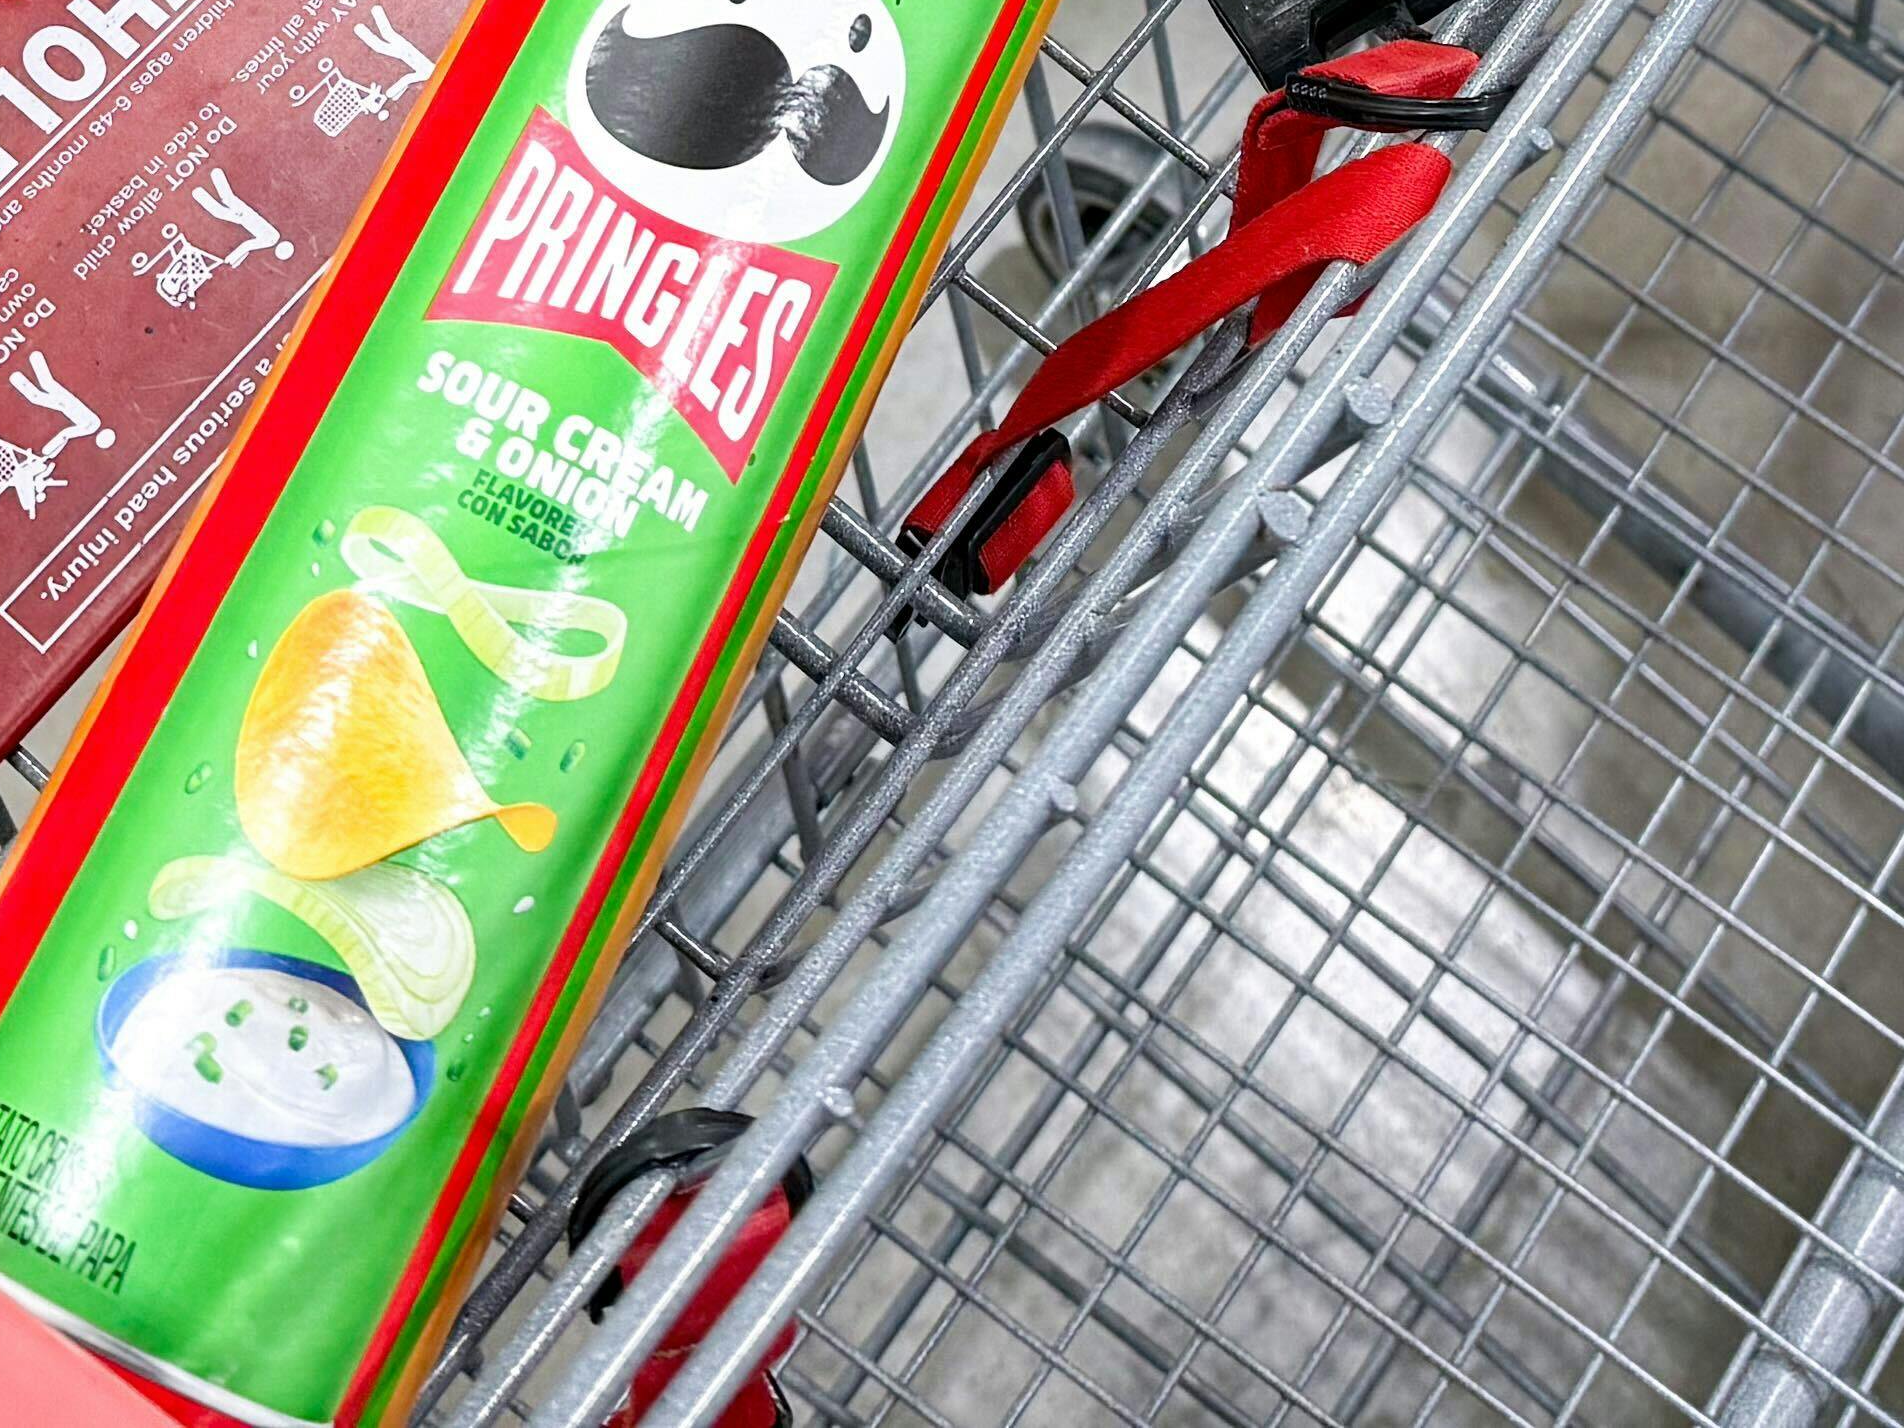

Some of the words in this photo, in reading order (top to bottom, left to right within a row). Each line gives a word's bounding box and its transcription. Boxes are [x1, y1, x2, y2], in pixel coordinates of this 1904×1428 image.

[281, 14, 305, 39] all
[293, 20, 331, 55] with
[129, 50, 174, 95] ages
[230, 36, 285, 82] times.
[257, 52, 295, 95] your
[88, 95, 133, 138] 6-48
[198, 102, 221, 121] to
[206, 115, 238, 145] Do
[163, 120, 199, 156] ride
[22, 134, 89, 200] months
[144, 155, 168, 176] in
[165, 144, 210, 192] NOT
[118, 187, 163, 235] allow
[72, 234, 117, 281] child
[23, 297, 56, 328] Do
[452, 140, 812, 443] PRINGLES
[172, 376, 256, 466] serious
[416, 349, 552, 442] SOUR
[552, 414, 710, 534] CREAM
[114, 465, 178, 532] head
[454, 417, 496, 461] &
[495, 436, 643, 539] ONION
[457, 489, 507, 530] CON
[506, 506, 588, 566] SABOR
[40, 527, 120, 601] injury.
[64, 1214, 137, 1296] PAPA
